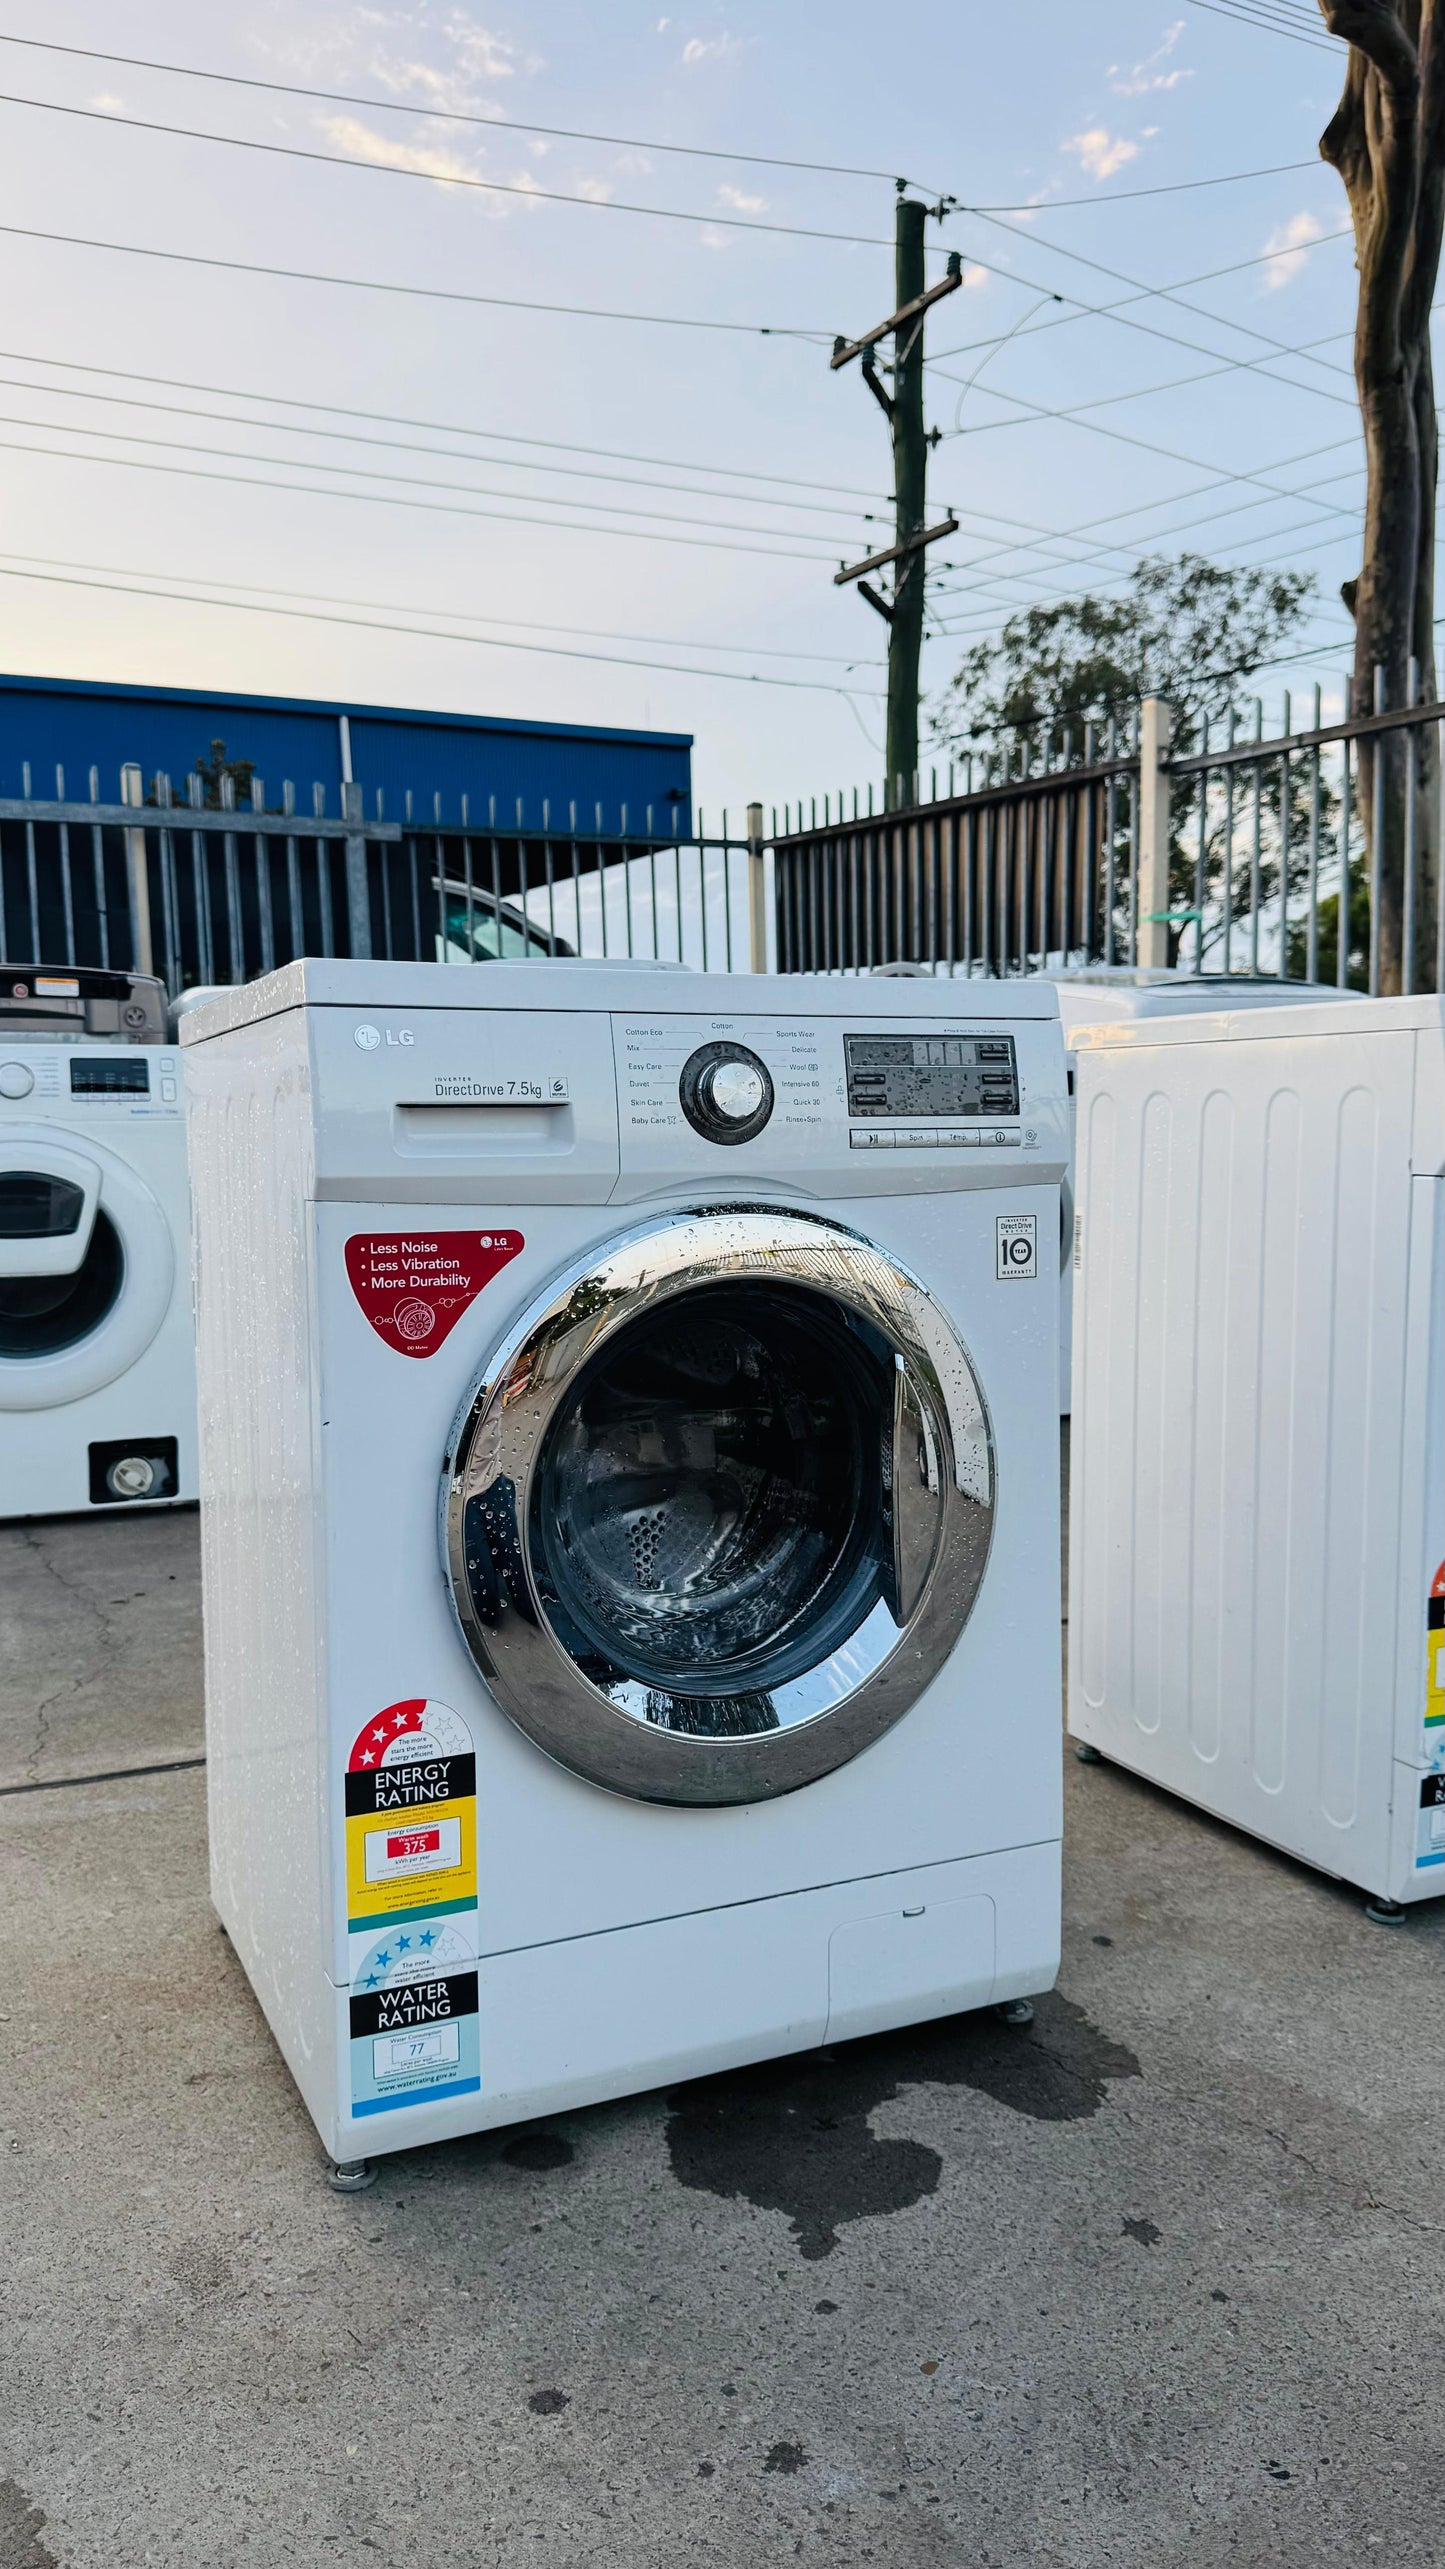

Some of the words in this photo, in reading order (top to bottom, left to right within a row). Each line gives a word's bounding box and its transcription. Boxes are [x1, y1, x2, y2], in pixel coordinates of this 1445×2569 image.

[385, 1028, 415, 1046] LG
[776, 1030, 797, 1038] Sports
[631, 1116, 649, 1125] Baby
[370, 1243, 398, 1254] Less
[401, 1242, 438, 1253] Noise
[494, 1238, 507, 1246] LG
[1002, 1238, 1032, 1265] 10
[370, 1260, 398, 1272] Less
[401, 1258, 460, 1270] Vibration
[371, 1277, 406, 1288] More
[410, 1273, 471, 1288] Durability
[375, 1762, 451, 1789] ENERGY
[375, 1781, 449, 1808] RATING
[406, 1823, 439, 1833] consumption
[404, 1840, 426, 1854] 375
[379, 1982, 448, 2009] WATER
[378, 2000, 451, 2029] RATING
[410, 2043, 424, 2056] 77
[378, 2072, 456, 2092] www.waterrating.gov.au
